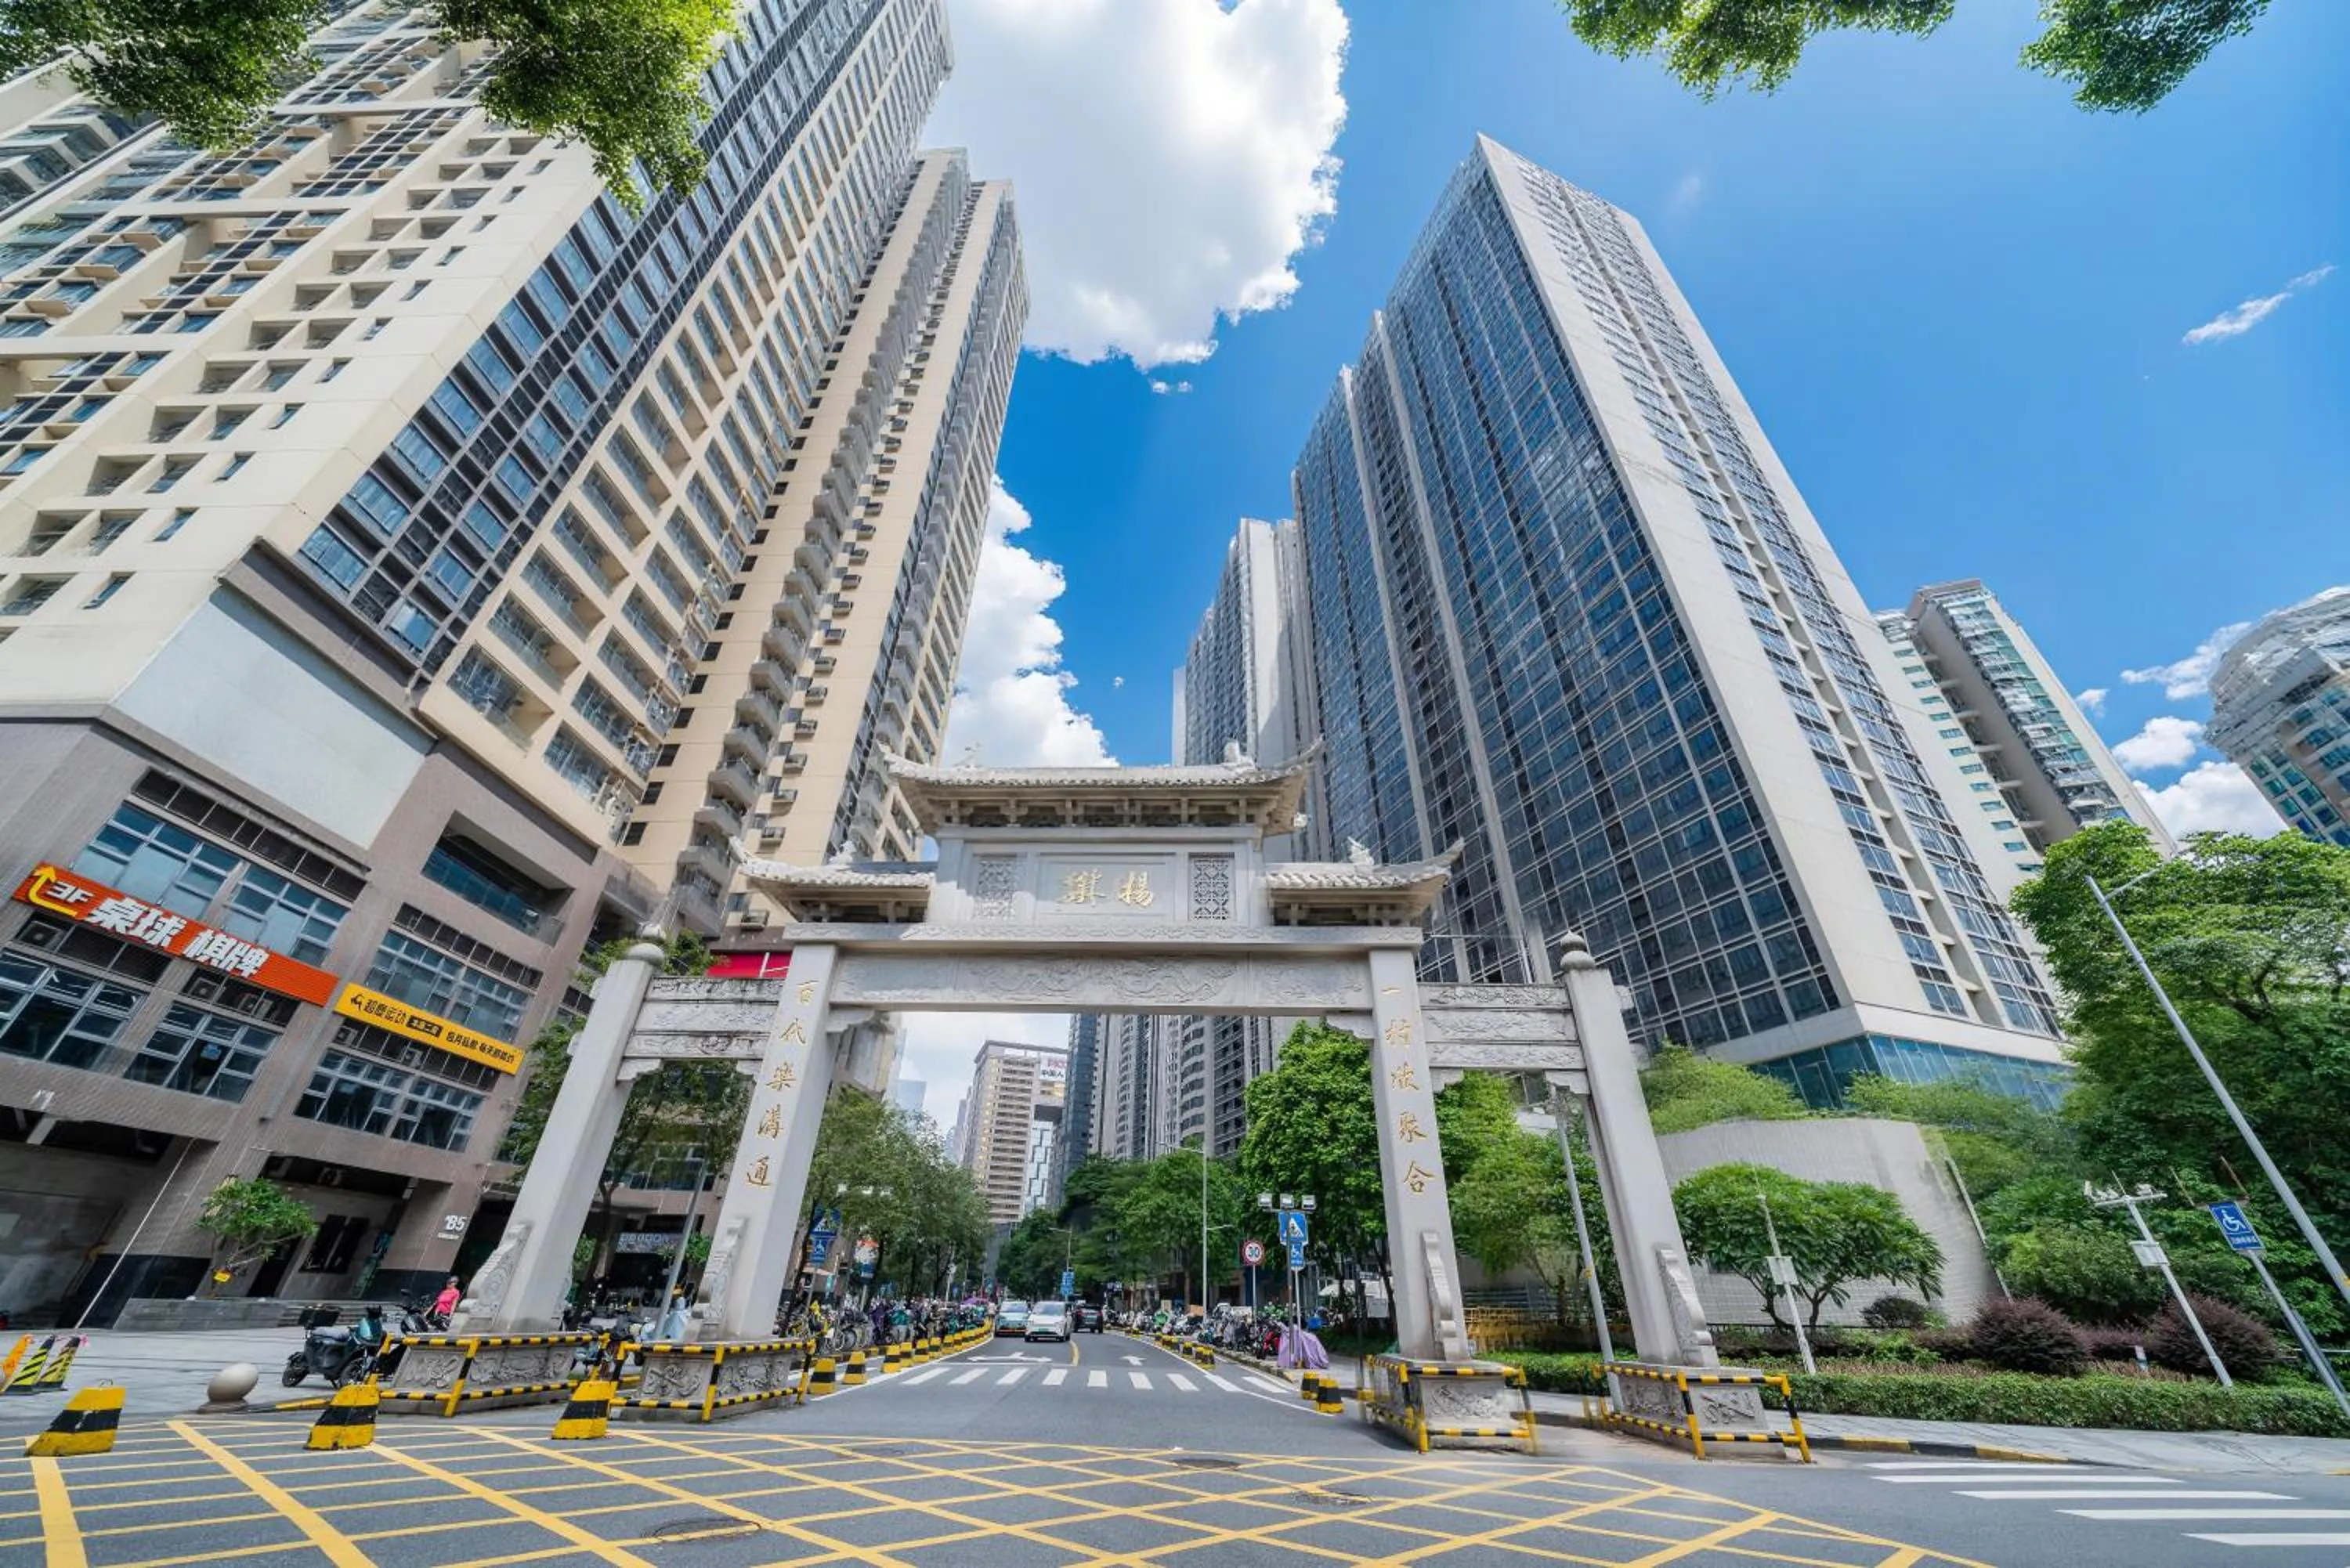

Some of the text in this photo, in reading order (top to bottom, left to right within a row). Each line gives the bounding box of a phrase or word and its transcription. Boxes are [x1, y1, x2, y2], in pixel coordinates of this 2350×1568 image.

[46, 880, 270, 977] 3F 桌球 棋牌
